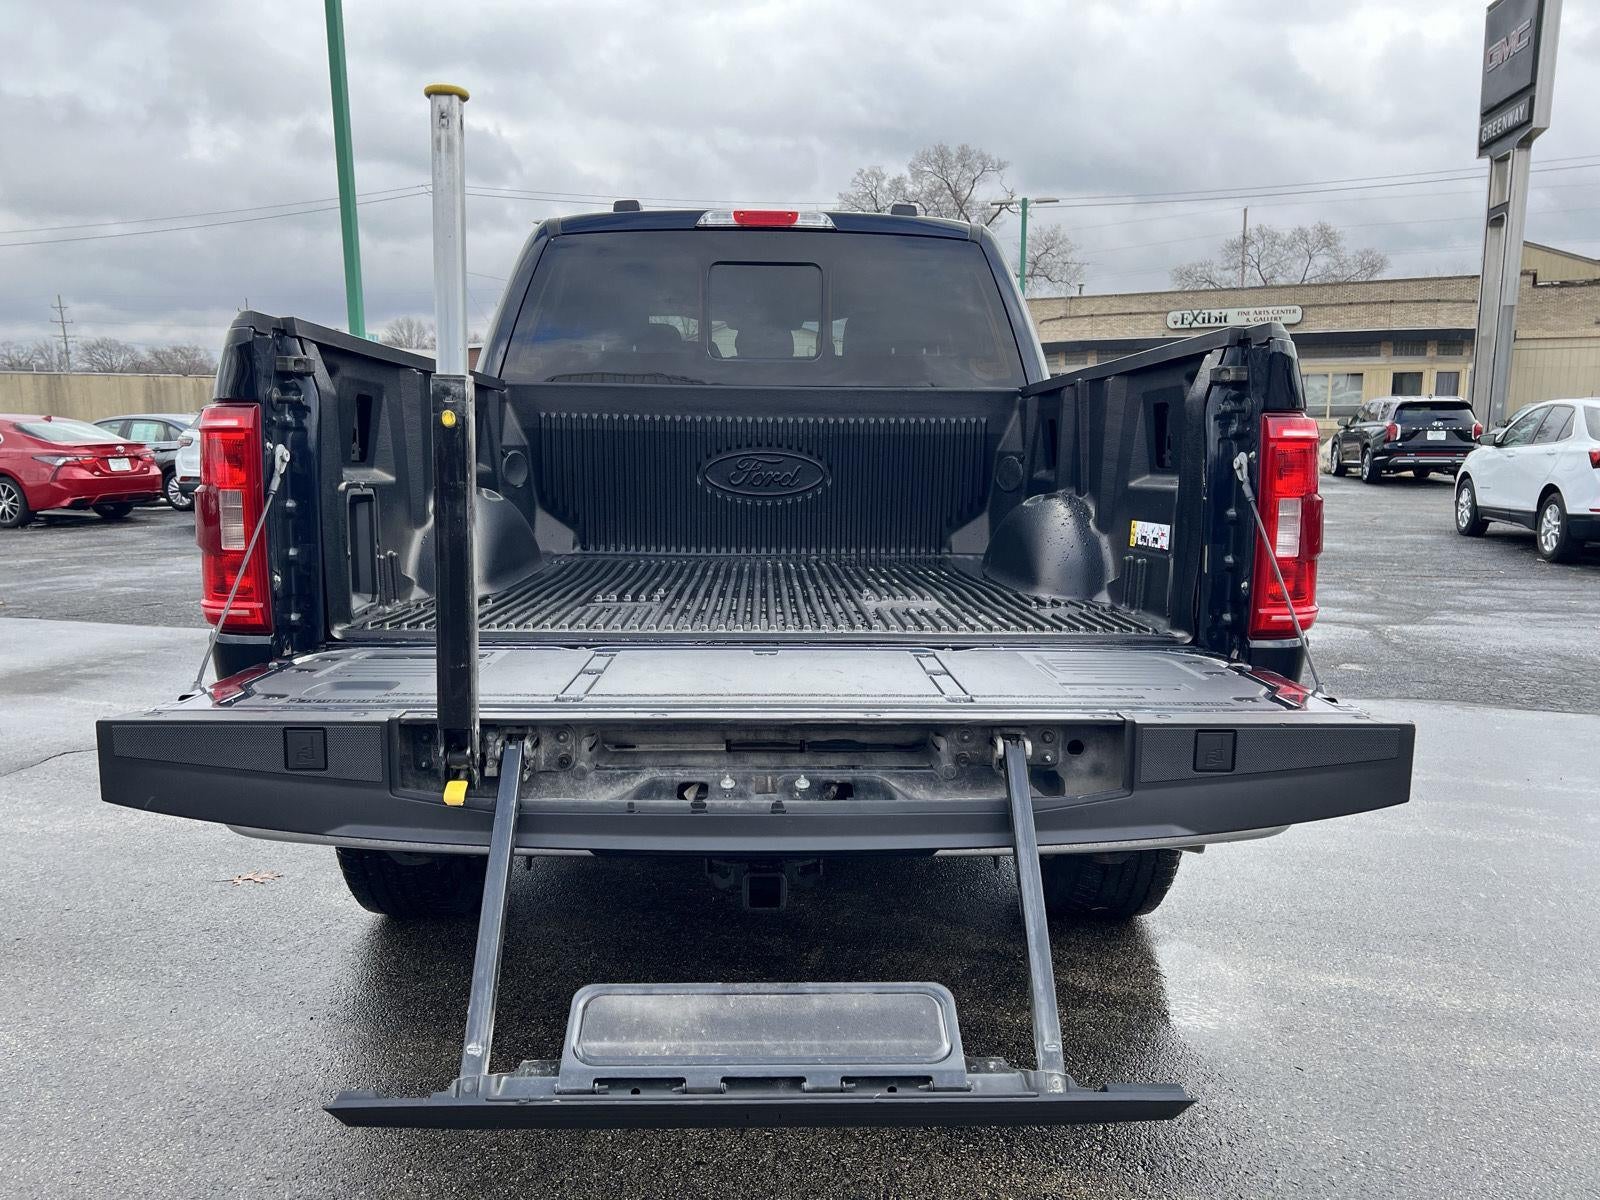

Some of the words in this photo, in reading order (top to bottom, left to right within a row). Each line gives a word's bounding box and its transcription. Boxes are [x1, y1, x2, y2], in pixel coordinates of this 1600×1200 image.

[1487, 18, 1532, 73] GMC
[1481, 104, 1525, 142] GREENWAY
[729, 456, 802, 487] Ford
